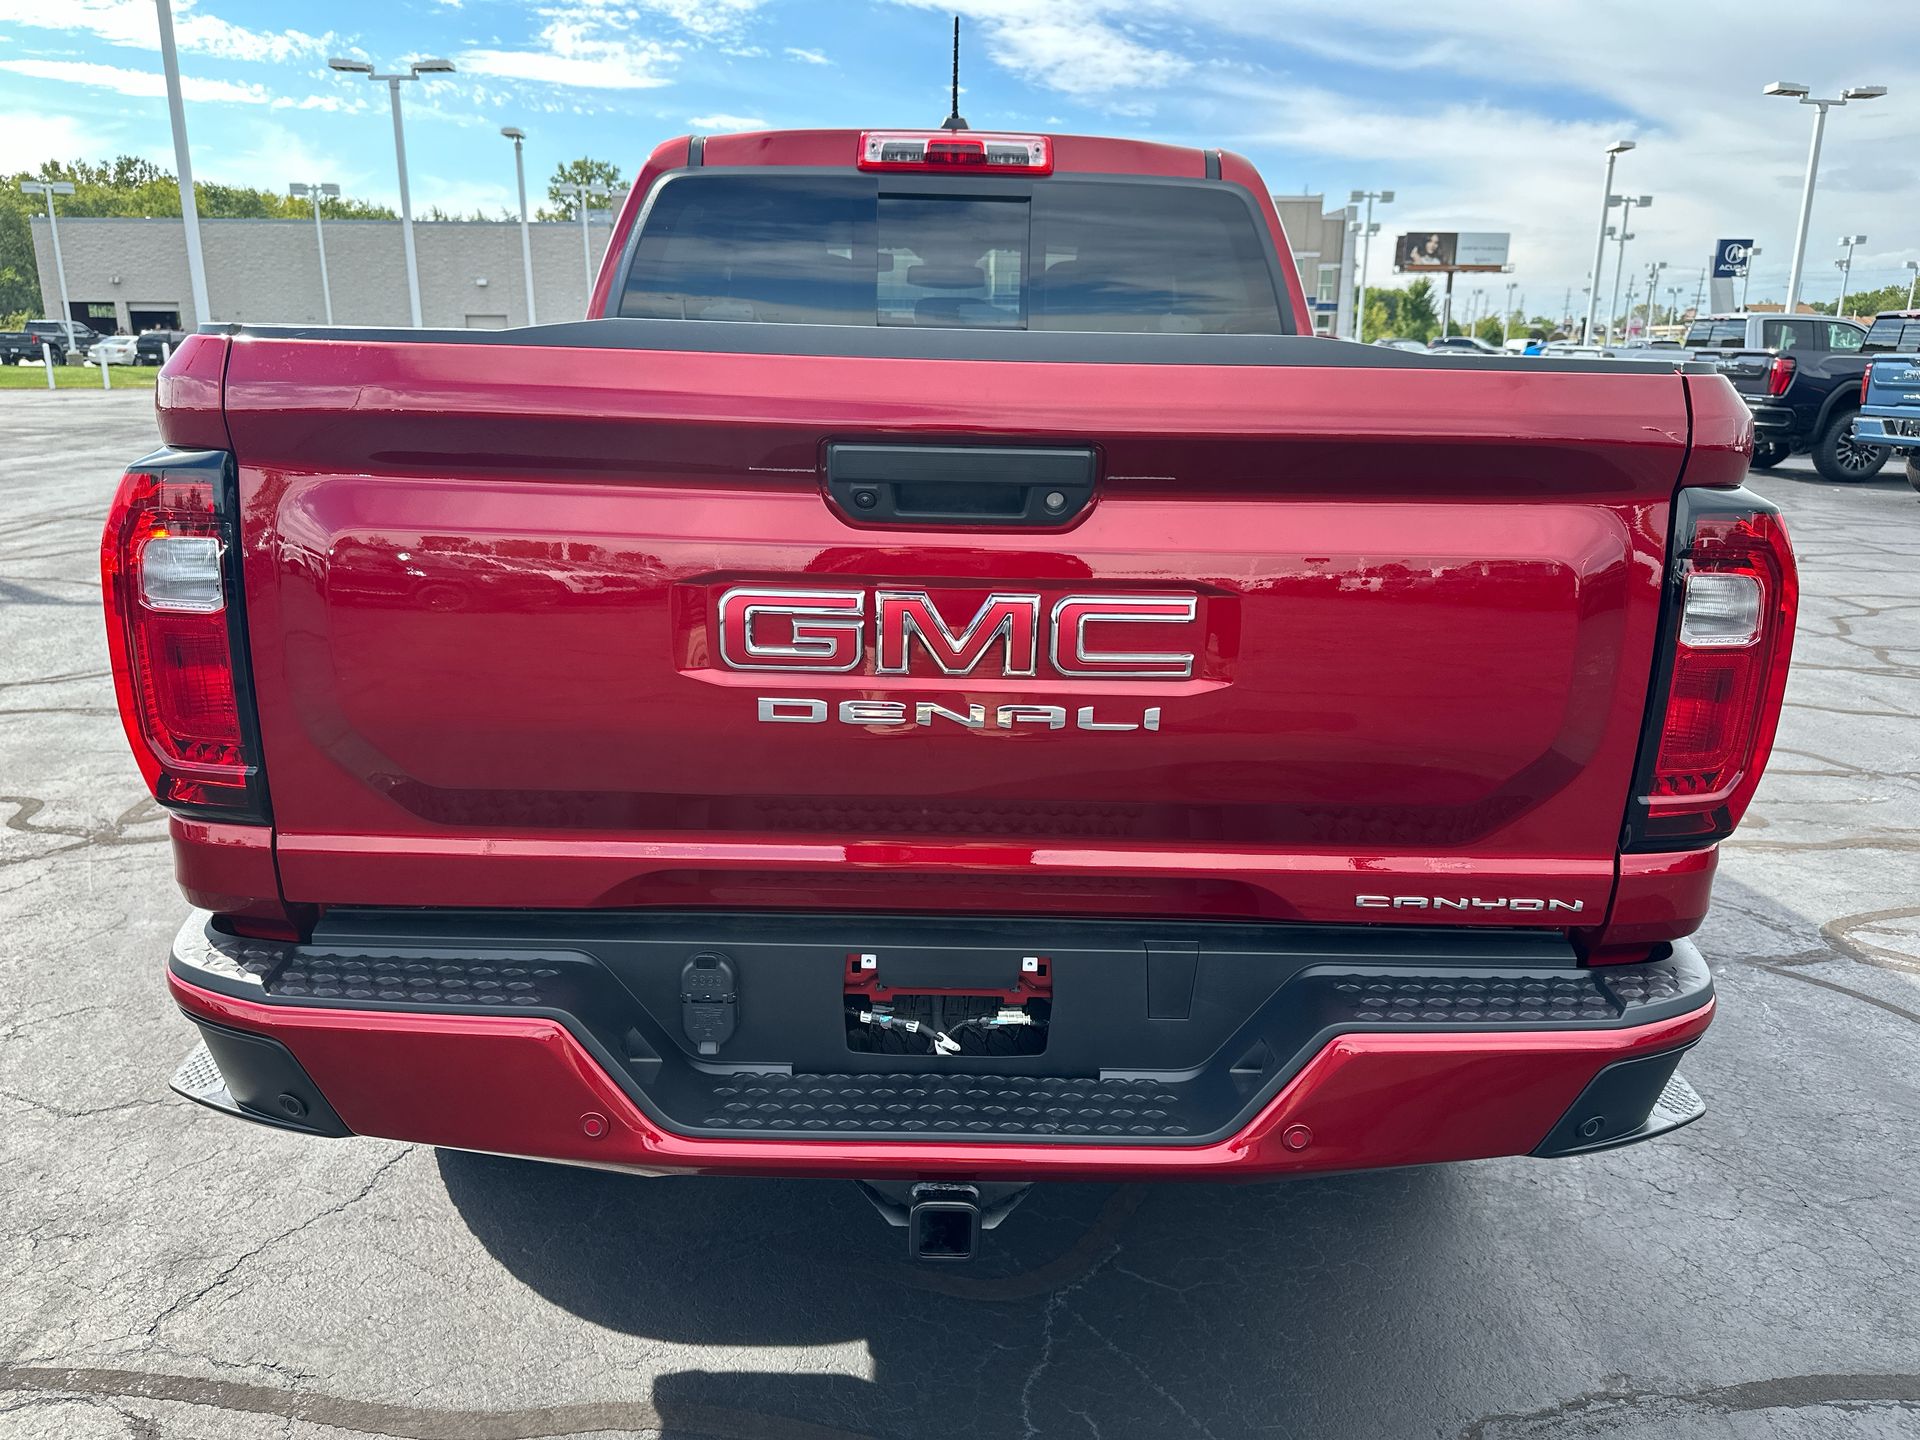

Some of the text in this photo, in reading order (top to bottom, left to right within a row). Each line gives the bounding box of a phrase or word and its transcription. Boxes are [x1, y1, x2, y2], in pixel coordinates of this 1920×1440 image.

[718, 587, 1197, 677] GMC
[757, 697, 1161, 730] DENALI
[1356, 895, 1584, 912] CANYON
